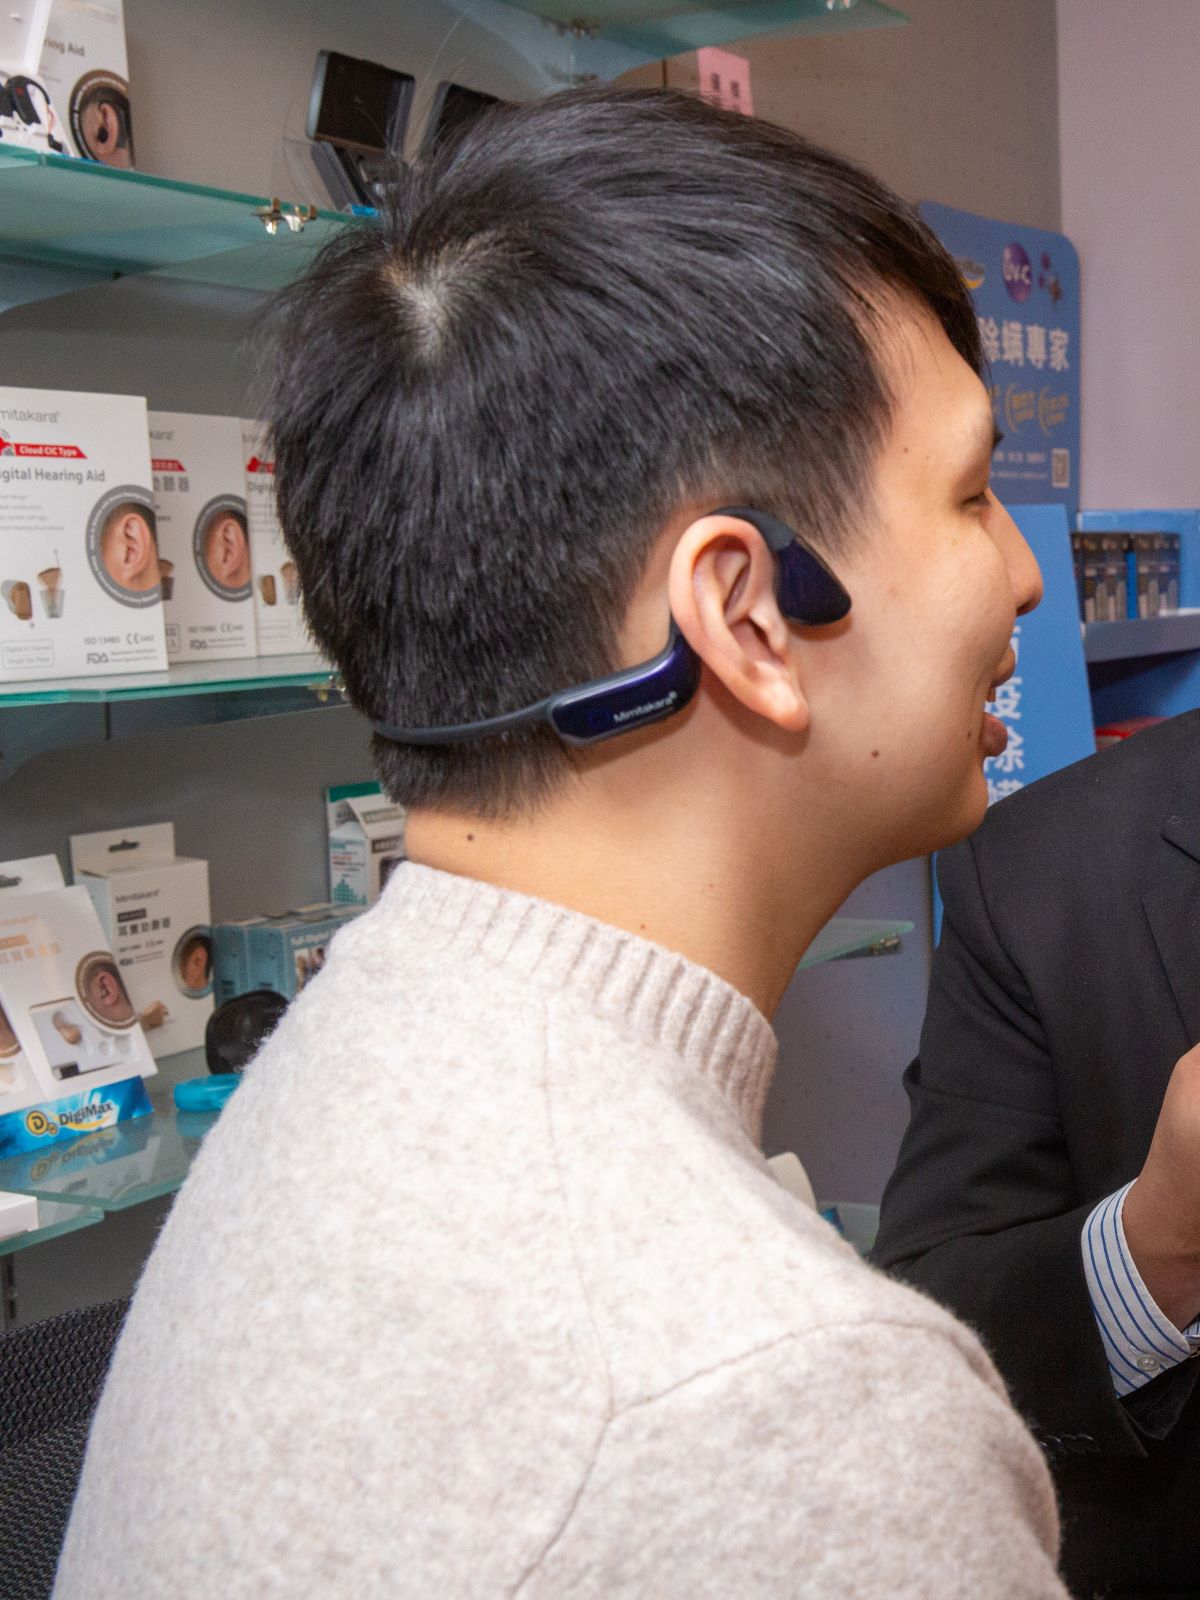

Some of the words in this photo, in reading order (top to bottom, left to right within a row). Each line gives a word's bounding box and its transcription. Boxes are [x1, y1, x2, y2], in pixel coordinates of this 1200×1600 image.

[19, 445, 43, 456] Cloud
[58, 447, 78, 457] Type
[34, 468, 83, 484] Hearing
[86, 470, 106, 482] Aid
[86, 652, 109, 664] FDA
[59, 1102, 114, 1126] DigiMax
